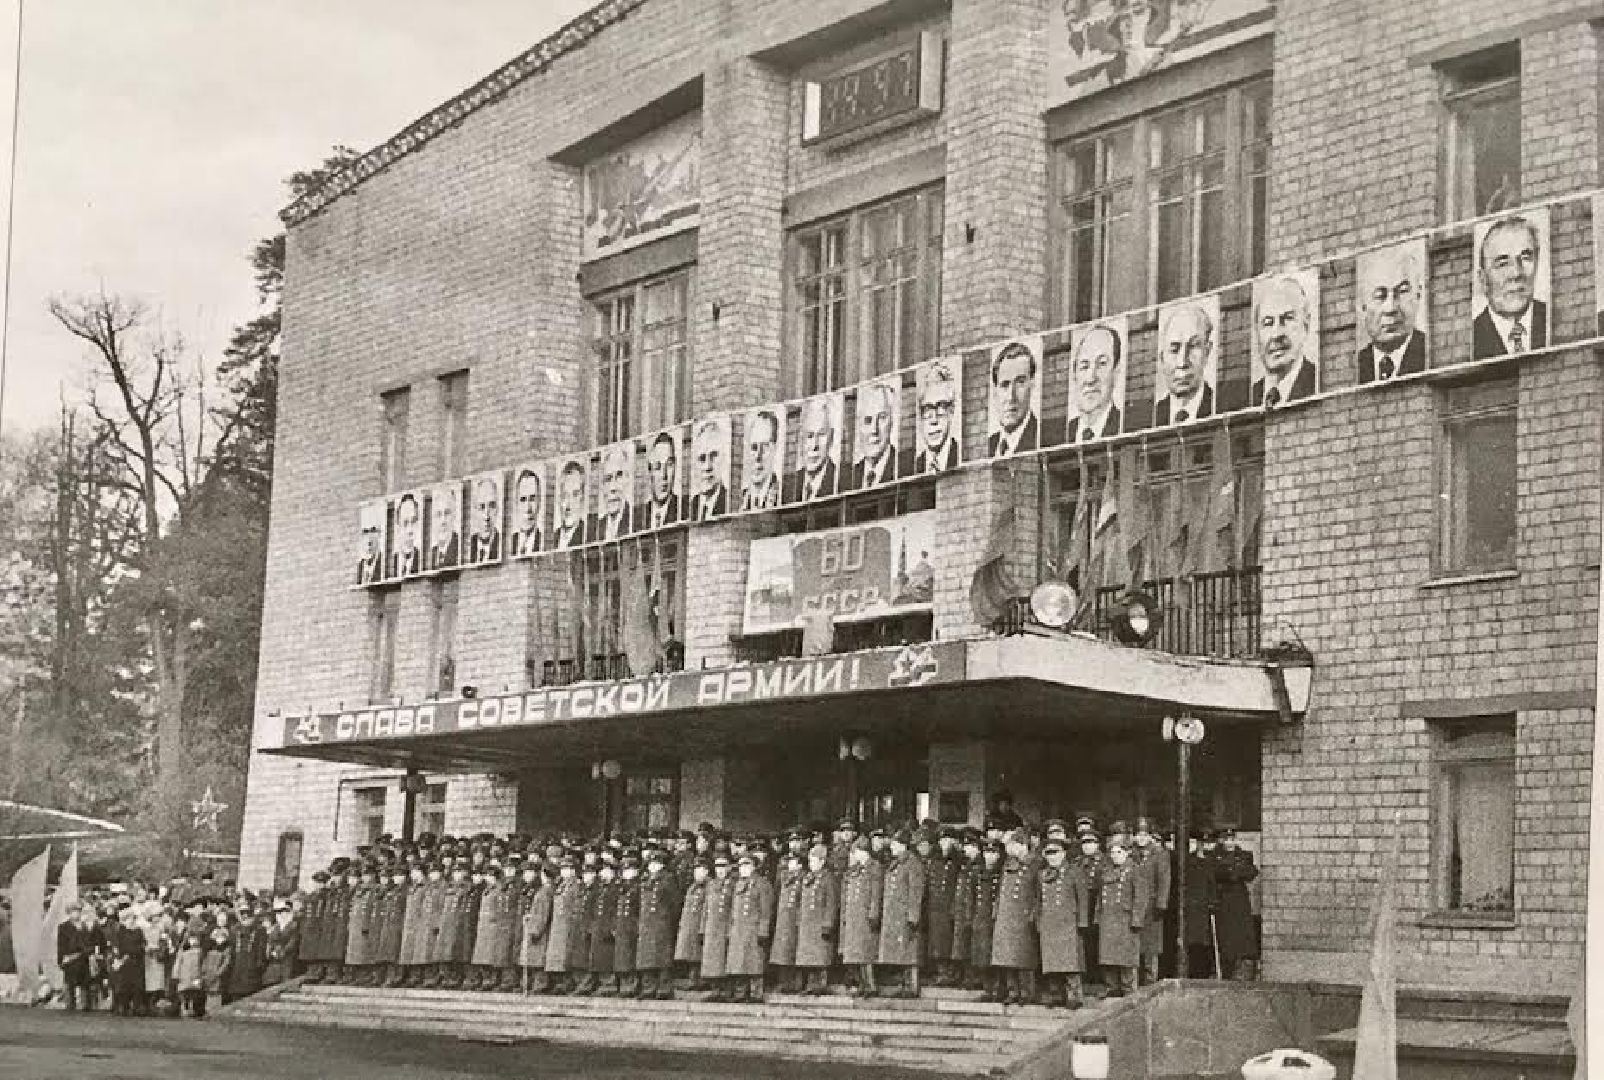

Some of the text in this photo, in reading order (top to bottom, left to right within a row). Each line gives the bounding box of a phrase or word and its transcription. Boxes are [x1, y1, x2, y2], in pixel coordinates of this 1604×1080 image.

[821, 533, 864, 574] 60
[803, 585, 879, 616] СССР
[337, 657, 861, 739] СЛАВА СОВЕТСКОЙ АРМИИ!
